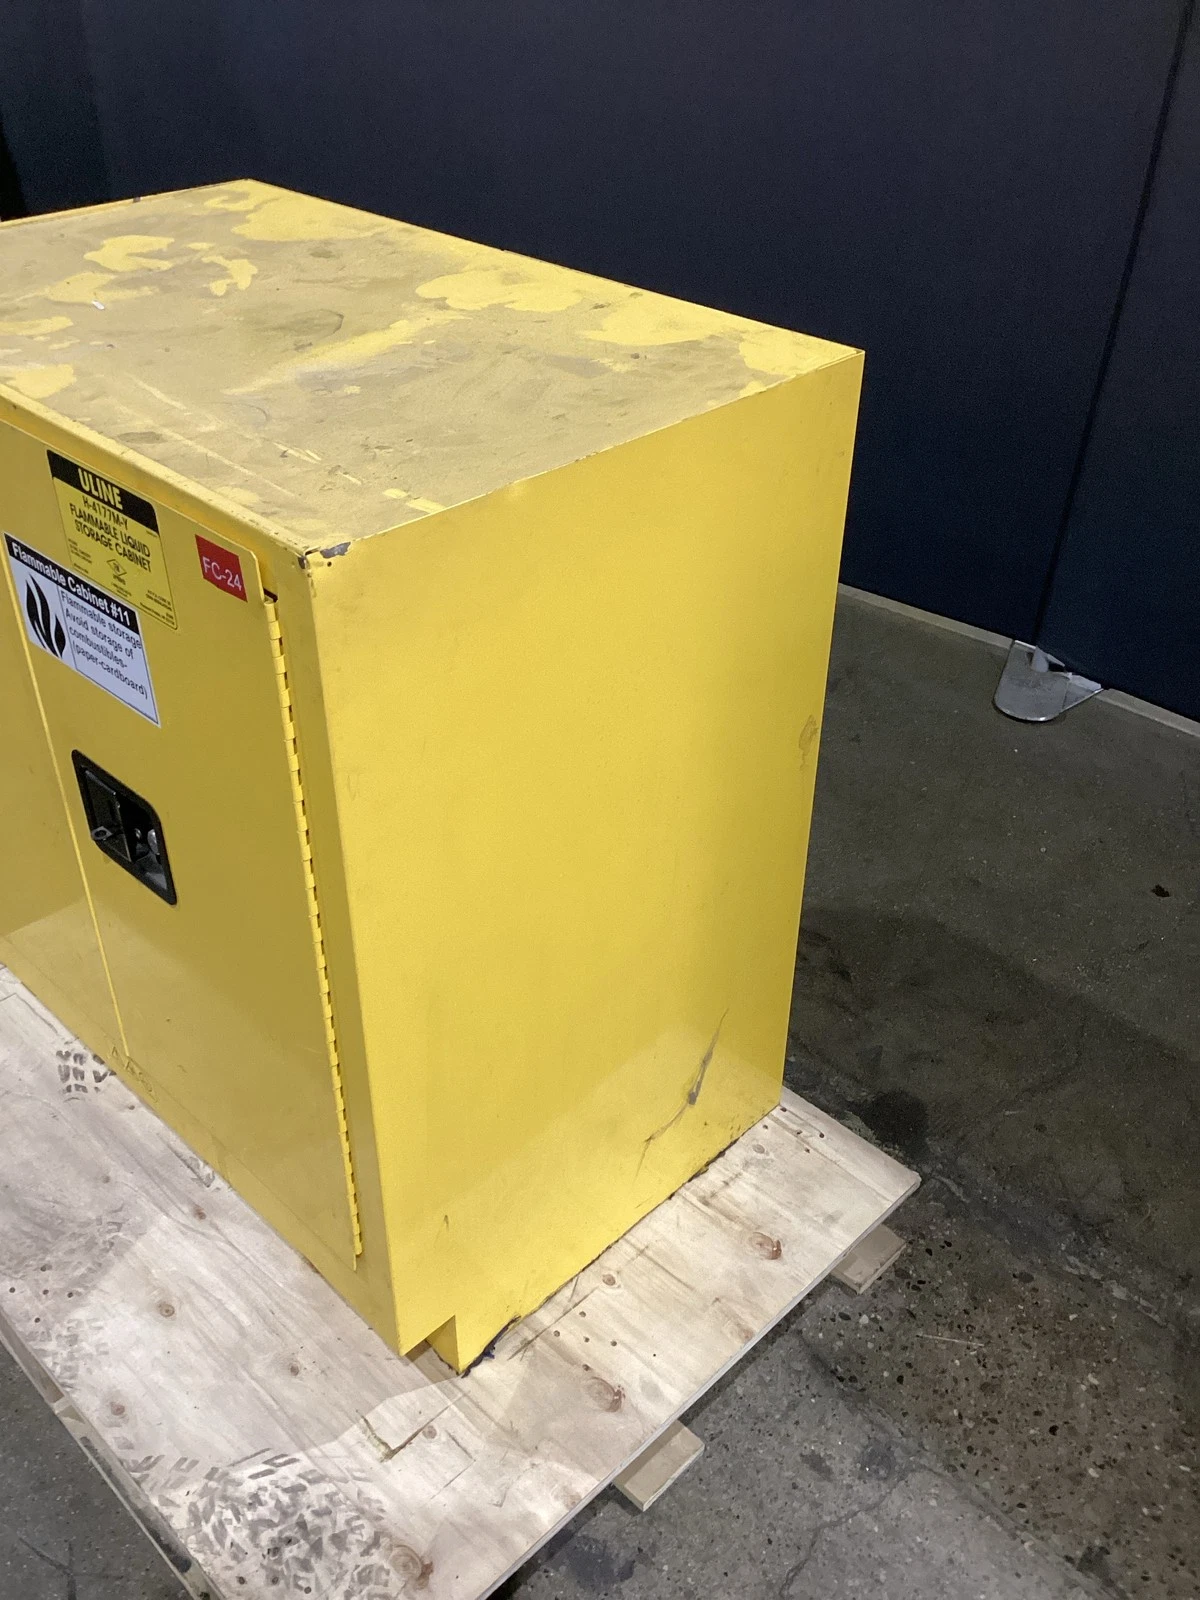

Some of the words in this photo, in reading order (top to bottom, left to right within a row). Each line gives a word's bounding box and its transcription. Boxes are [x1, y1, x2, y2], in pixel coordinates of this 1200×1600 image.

[78, 467, 123, 510] ULINE
[69, 503, 119, 541] FLAMMABLE
[120, 531, 150, 558] LIQUID
[75, 519, 113, 550] STORAGE
[115, 543, 151, 572] CABINET
[12, 543, 66, 587] Flammable
[68, 578, 110, 614] Cabinet
[110, 602, 131, 626] #11
[202, 556, 242, 592] FC-24
[61, 592, 106, 627] Flammable
[108, 619, 142, 650] storage
[66, 608, 89, 631] Avoid
[91, 624, 123, 652] storage
[125, 647, 134, 660] of
[72, 641, 148, 700] (paper-cardboard)
